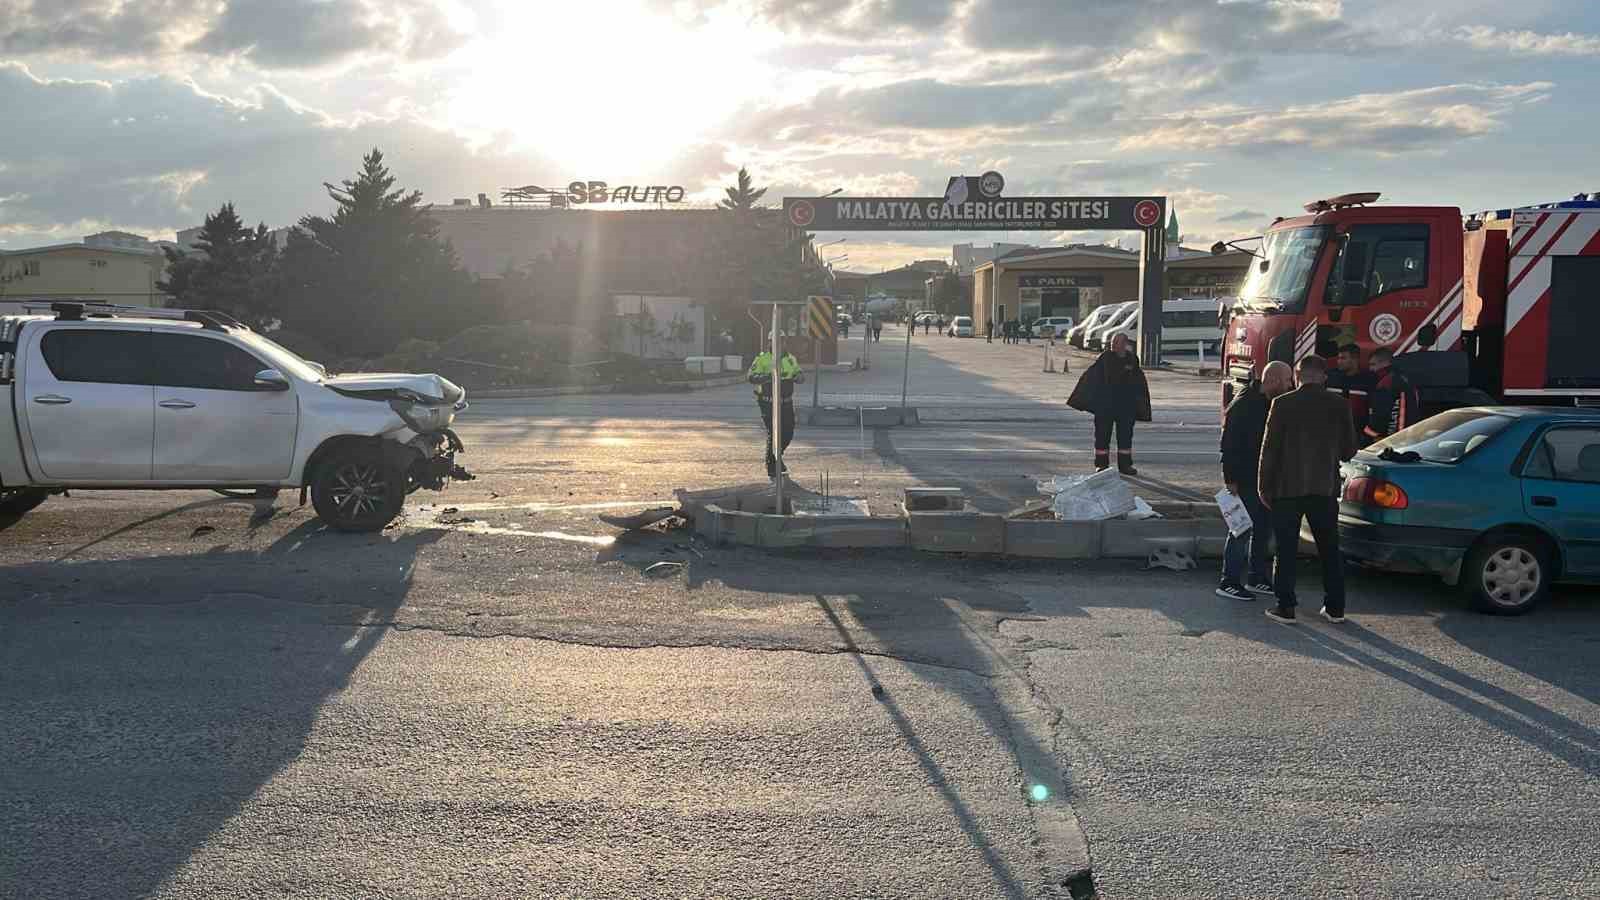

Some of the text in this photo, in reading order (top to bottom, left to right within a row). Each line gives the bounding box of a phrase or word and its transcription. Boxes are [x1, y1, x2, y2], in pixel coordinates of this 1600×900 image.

[568, 181, 685, 204] SB AUTO
[836, 201, 921, 219] MALATYA
